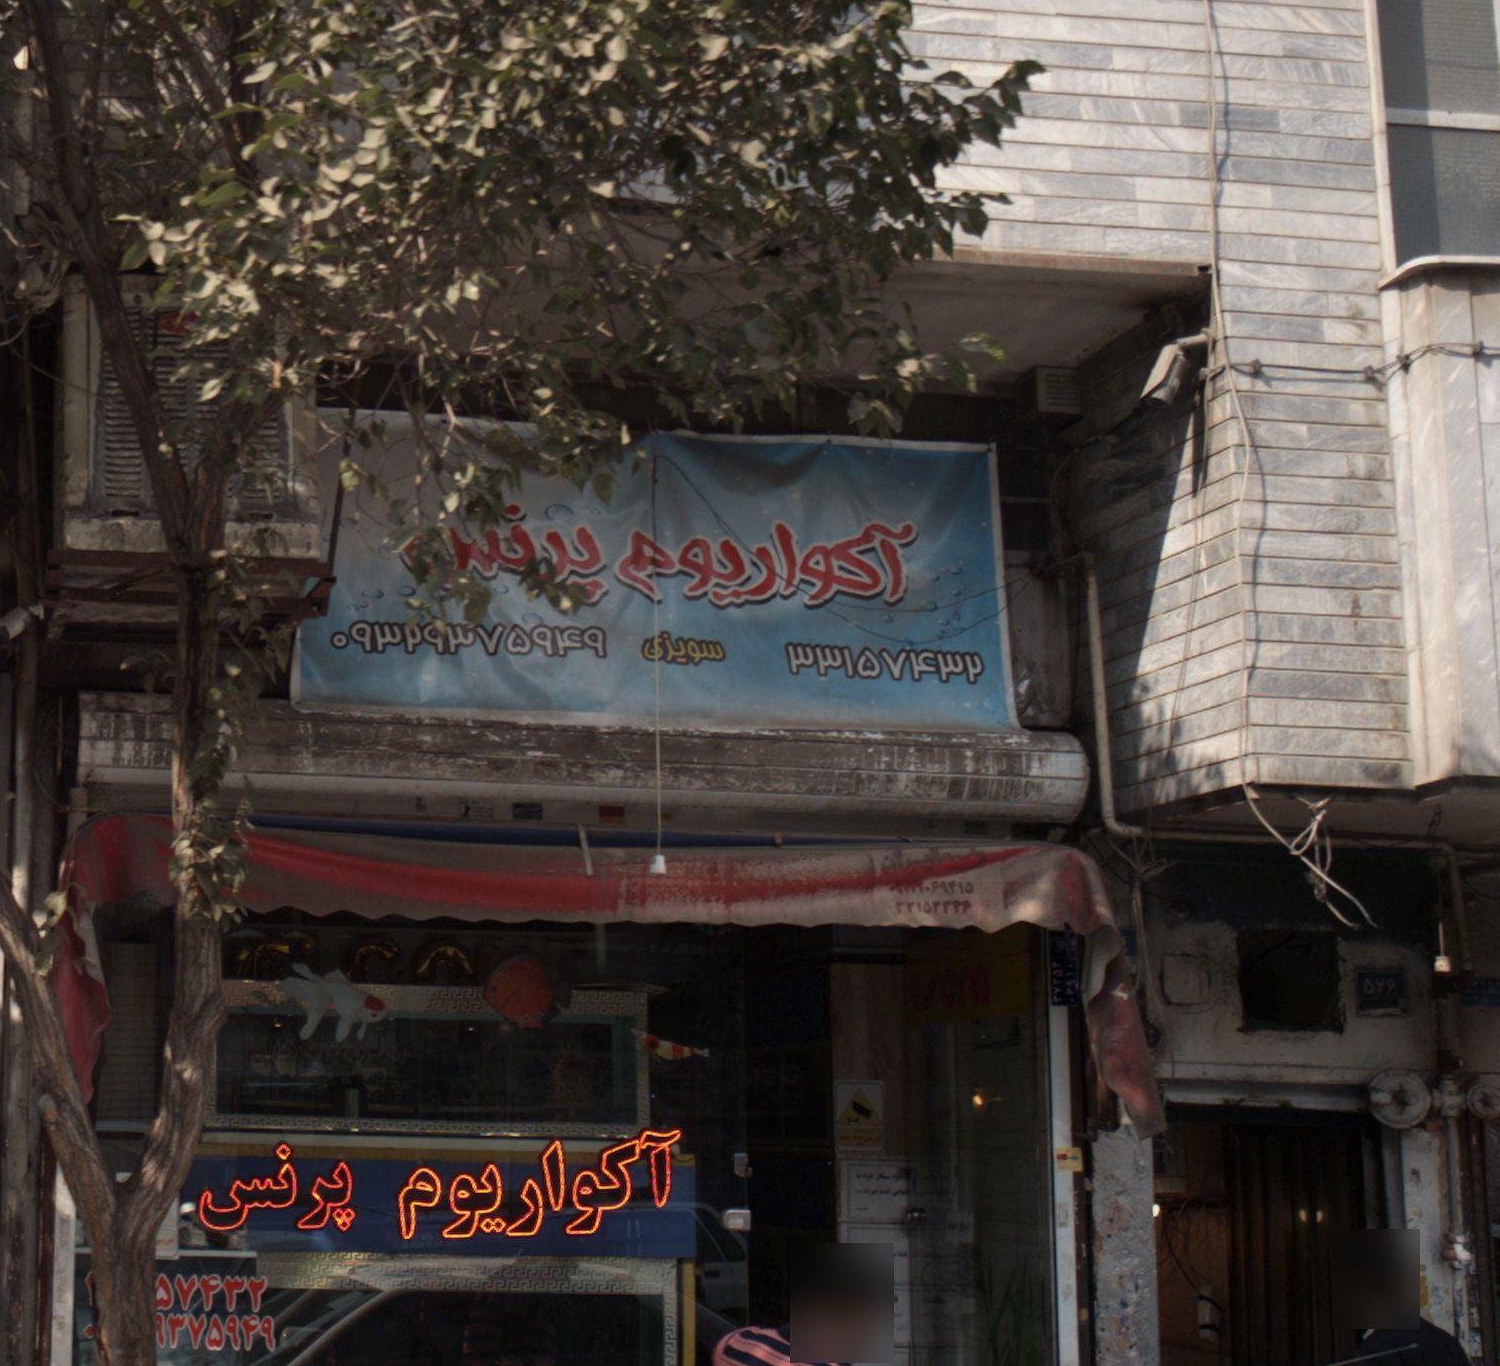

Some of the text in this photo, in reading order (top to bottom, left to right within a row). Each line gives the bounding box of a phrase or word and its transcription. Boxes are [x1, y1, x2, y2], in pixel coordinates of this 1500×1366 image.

[615, 521, 916, 607] آکواریوم
[785, 641, 985, 684] ۳۳۱۵۷۴۳۲
[198, 1129, 682, 1241] آکواریوم پرنس
